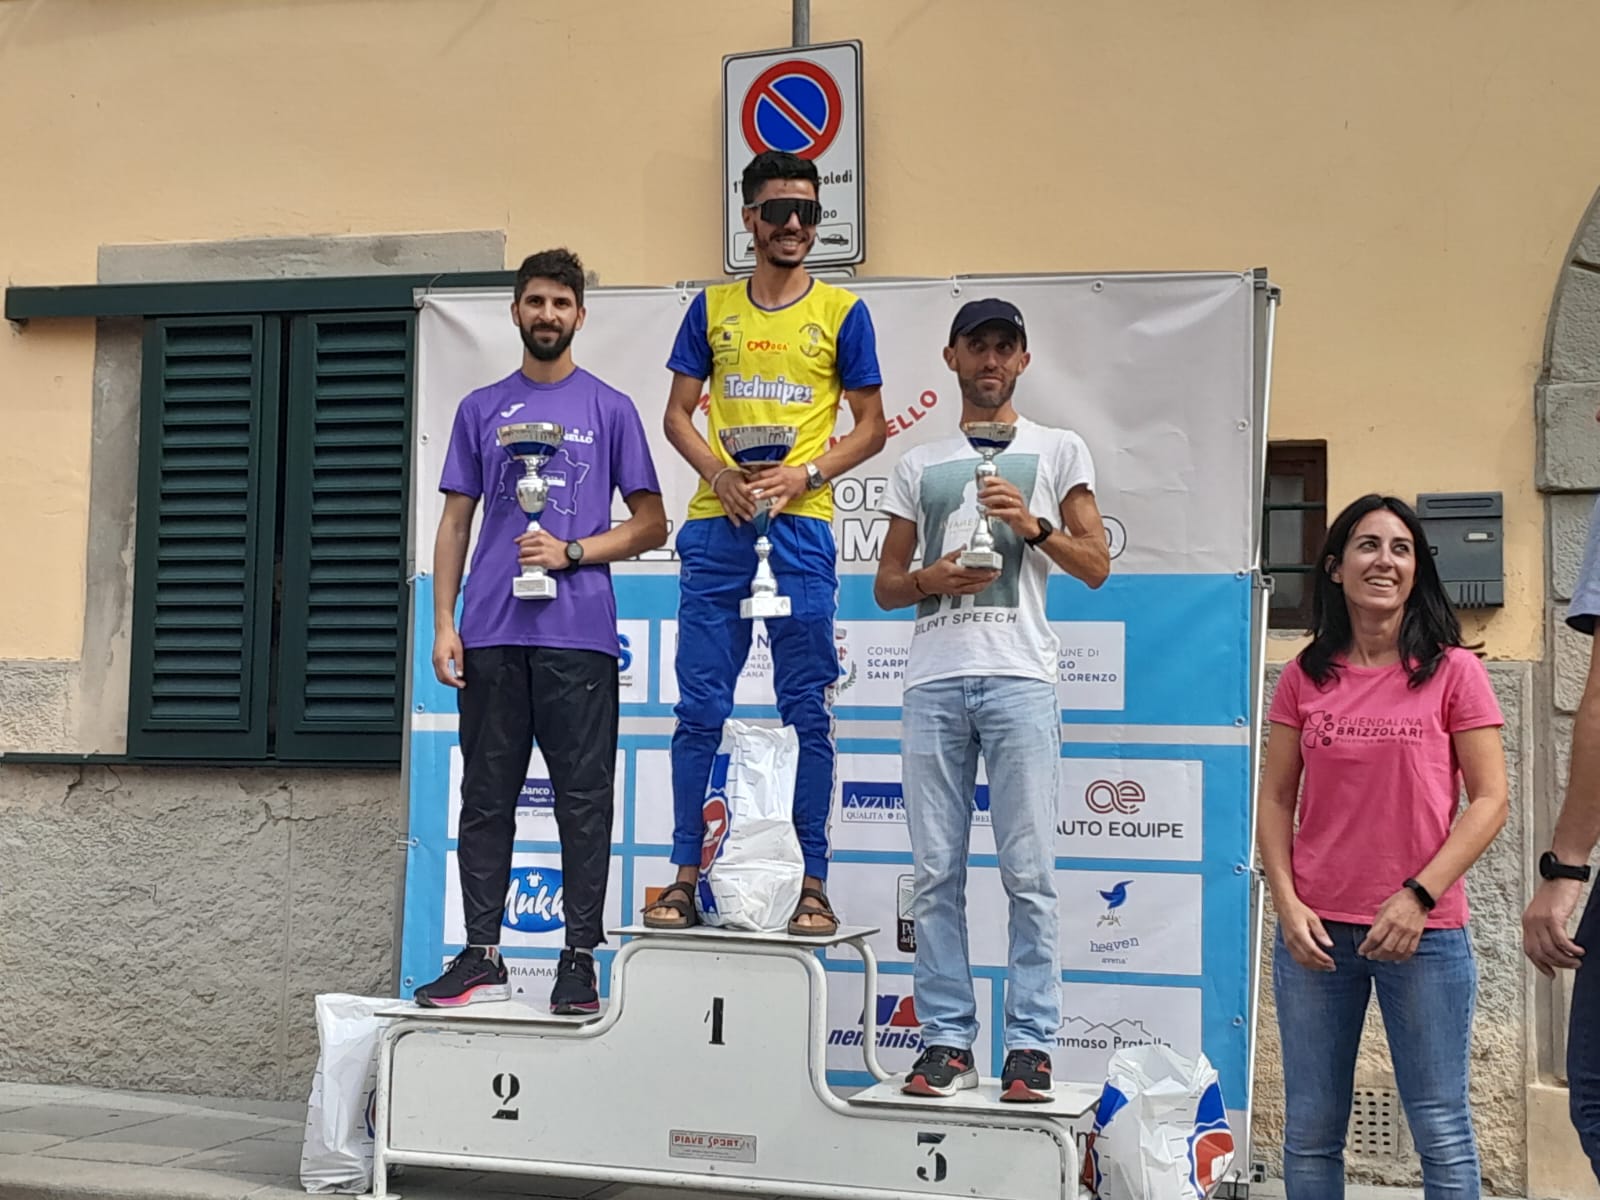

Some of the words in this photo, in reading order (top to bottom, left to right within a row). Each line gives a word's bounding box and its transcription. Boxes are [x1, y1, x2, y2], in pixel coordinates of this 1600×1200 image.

[726, 374, 814, 405] Technipes
[952, 611, 1017, 624] SPEECH
[1087, 648, 1100, 657] DI
[867, 671, 890, 680] SAN
[1060, 673, 1118, 682] LORENZO
[1337, 716, 1424, 728] GUENDALINA
[1336, 726, 1424, 739] BRIZZOLARI
[1108, 821, 1184, 838] EQUIPE
[1090, 937, 1140, 953] heaven
[703, 996, 726, 1046] 1
[491, 1072, 521, 1122] 2
[674, 1135, 704, 1145] PIAVE
[916, 1131, 948, 1183] 3
